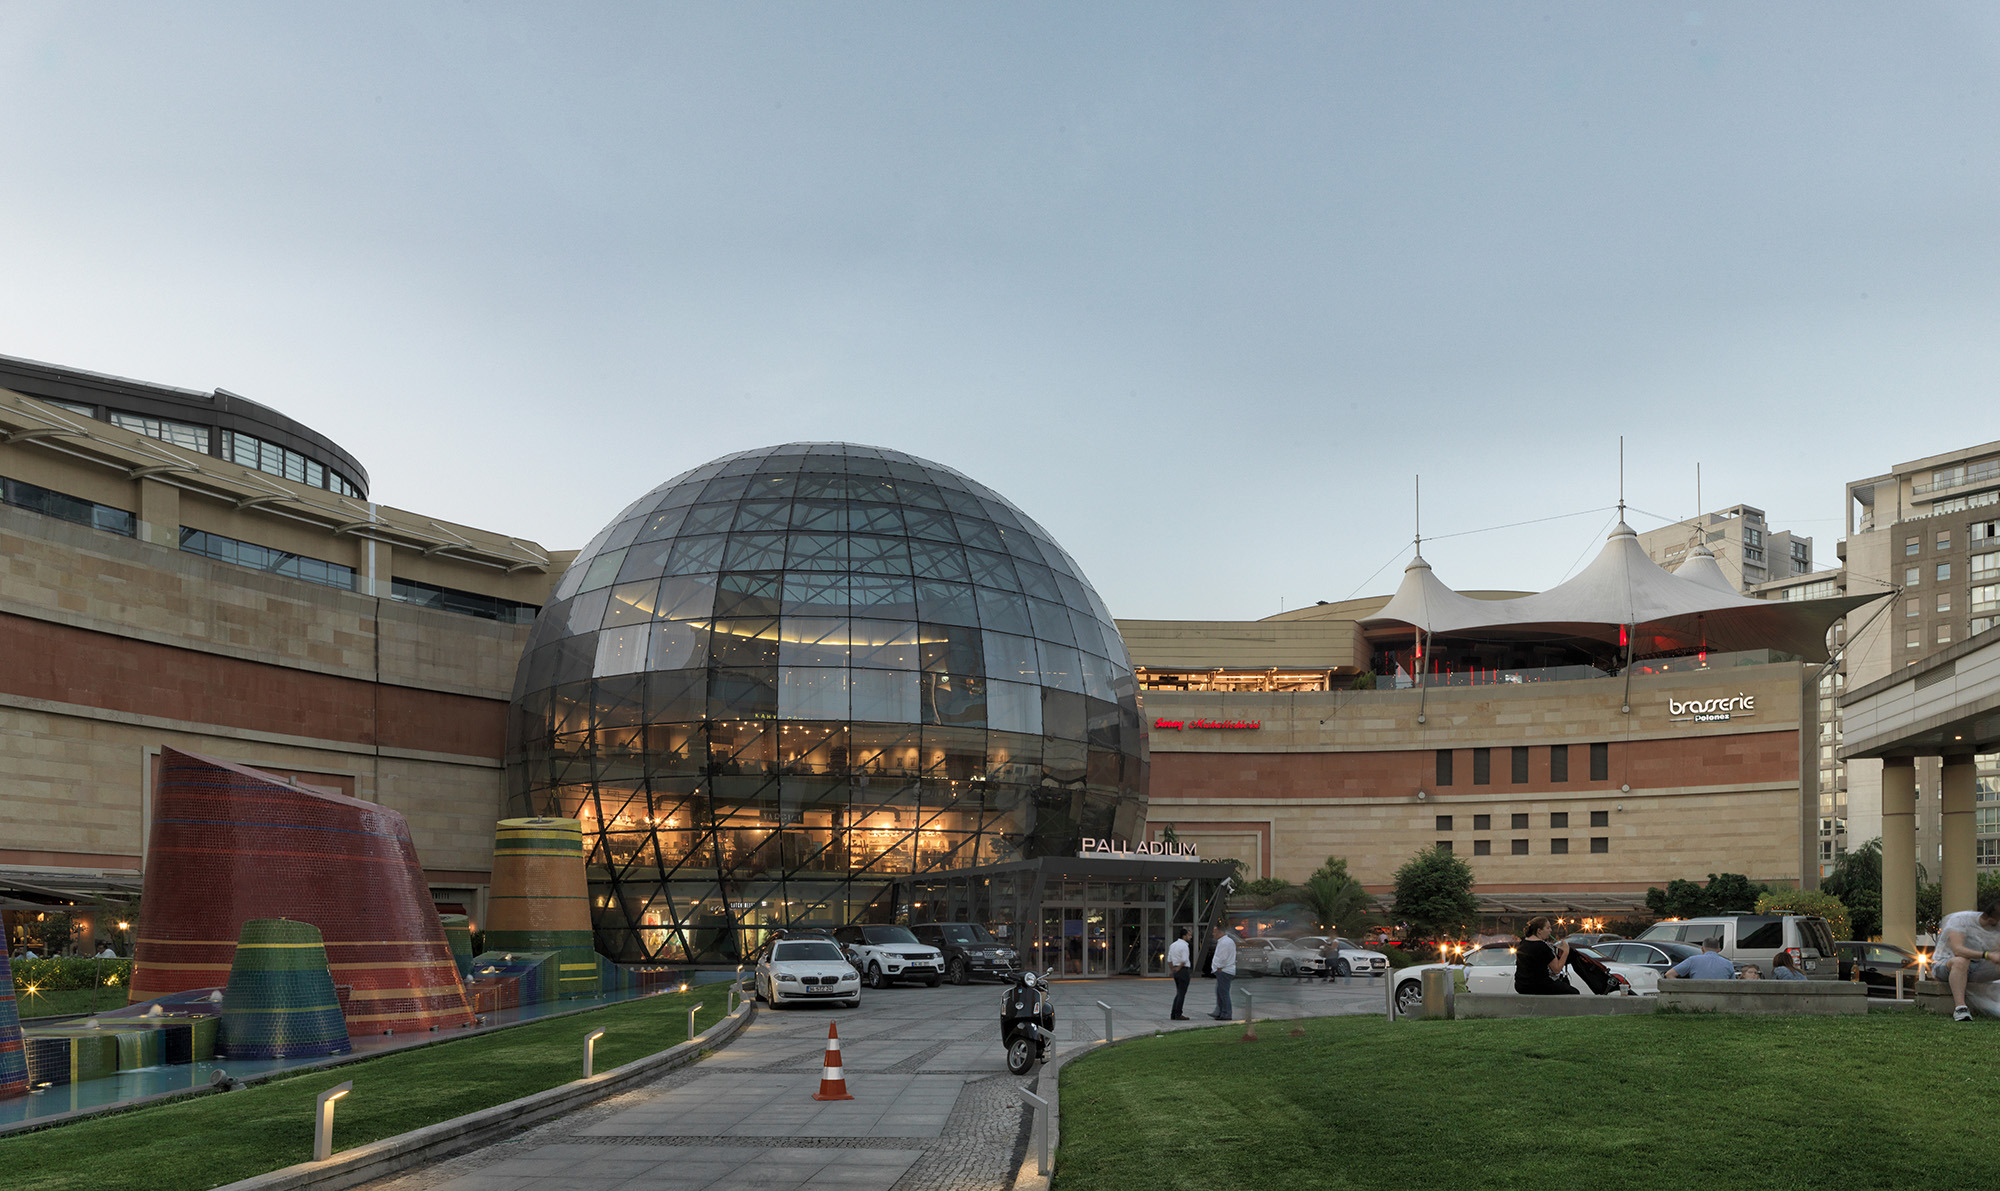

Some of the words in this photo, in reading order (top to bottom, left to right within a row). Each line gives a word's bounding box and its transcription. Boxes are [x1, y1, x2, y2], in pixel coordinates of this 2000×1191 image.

[1669, 692, 1754, 715] brasserie
[1154, 718, 1184, 731] Saray
[1082, 837, 1197, 856] PALLADIUM
